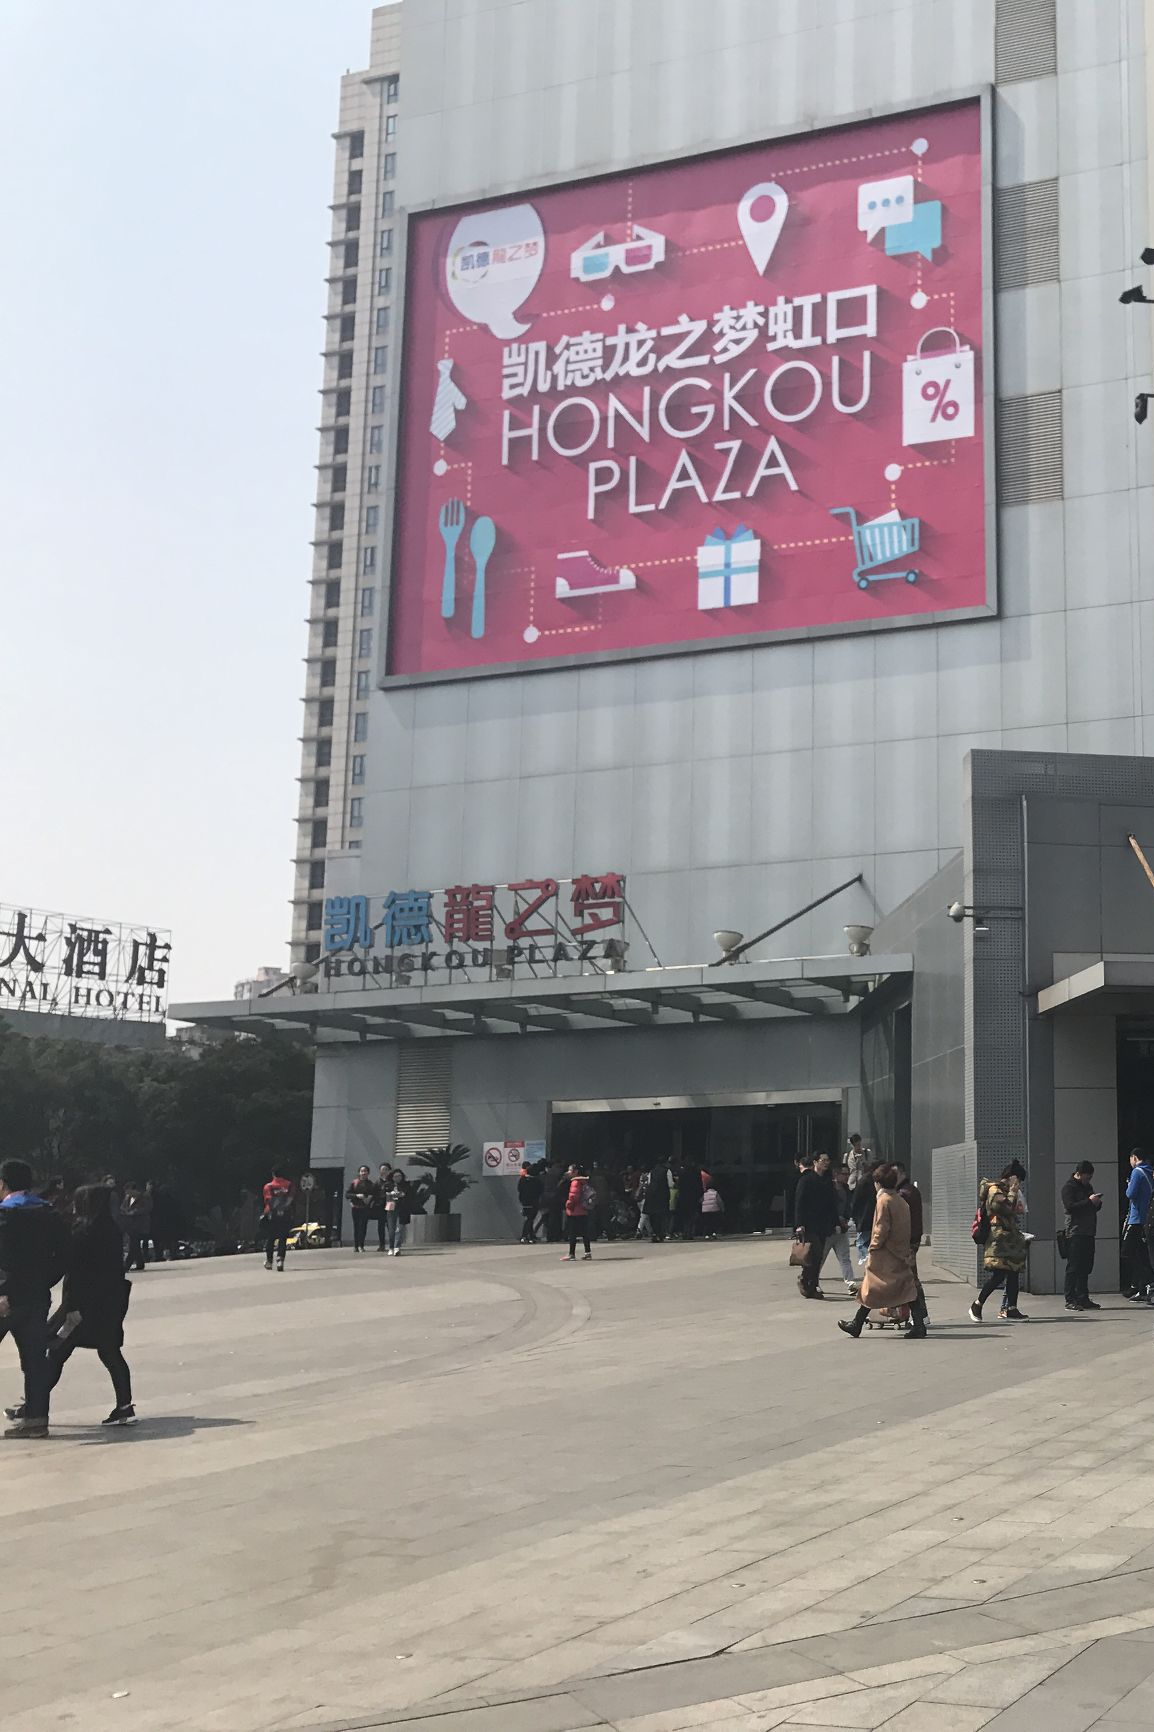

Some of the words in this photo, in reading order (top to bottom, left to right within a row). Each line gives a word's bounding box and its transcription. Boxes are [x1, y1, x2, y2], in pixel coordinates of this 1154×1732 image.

[501, 284, 879, 401] 凯德龙之梦虹口
[501, 350, 873, 466] HONGKOU
[586, 434, 800, 520] PLAZA
[0, 910, 172, 989] 大酒店
[324, 872, 627, 951] 凯德龍之梦
[324, 947, 494, 978] HONGKOU
[507, 937, 625, 966] PLAZA
[74, 986, 166, 1015] HOTEL
